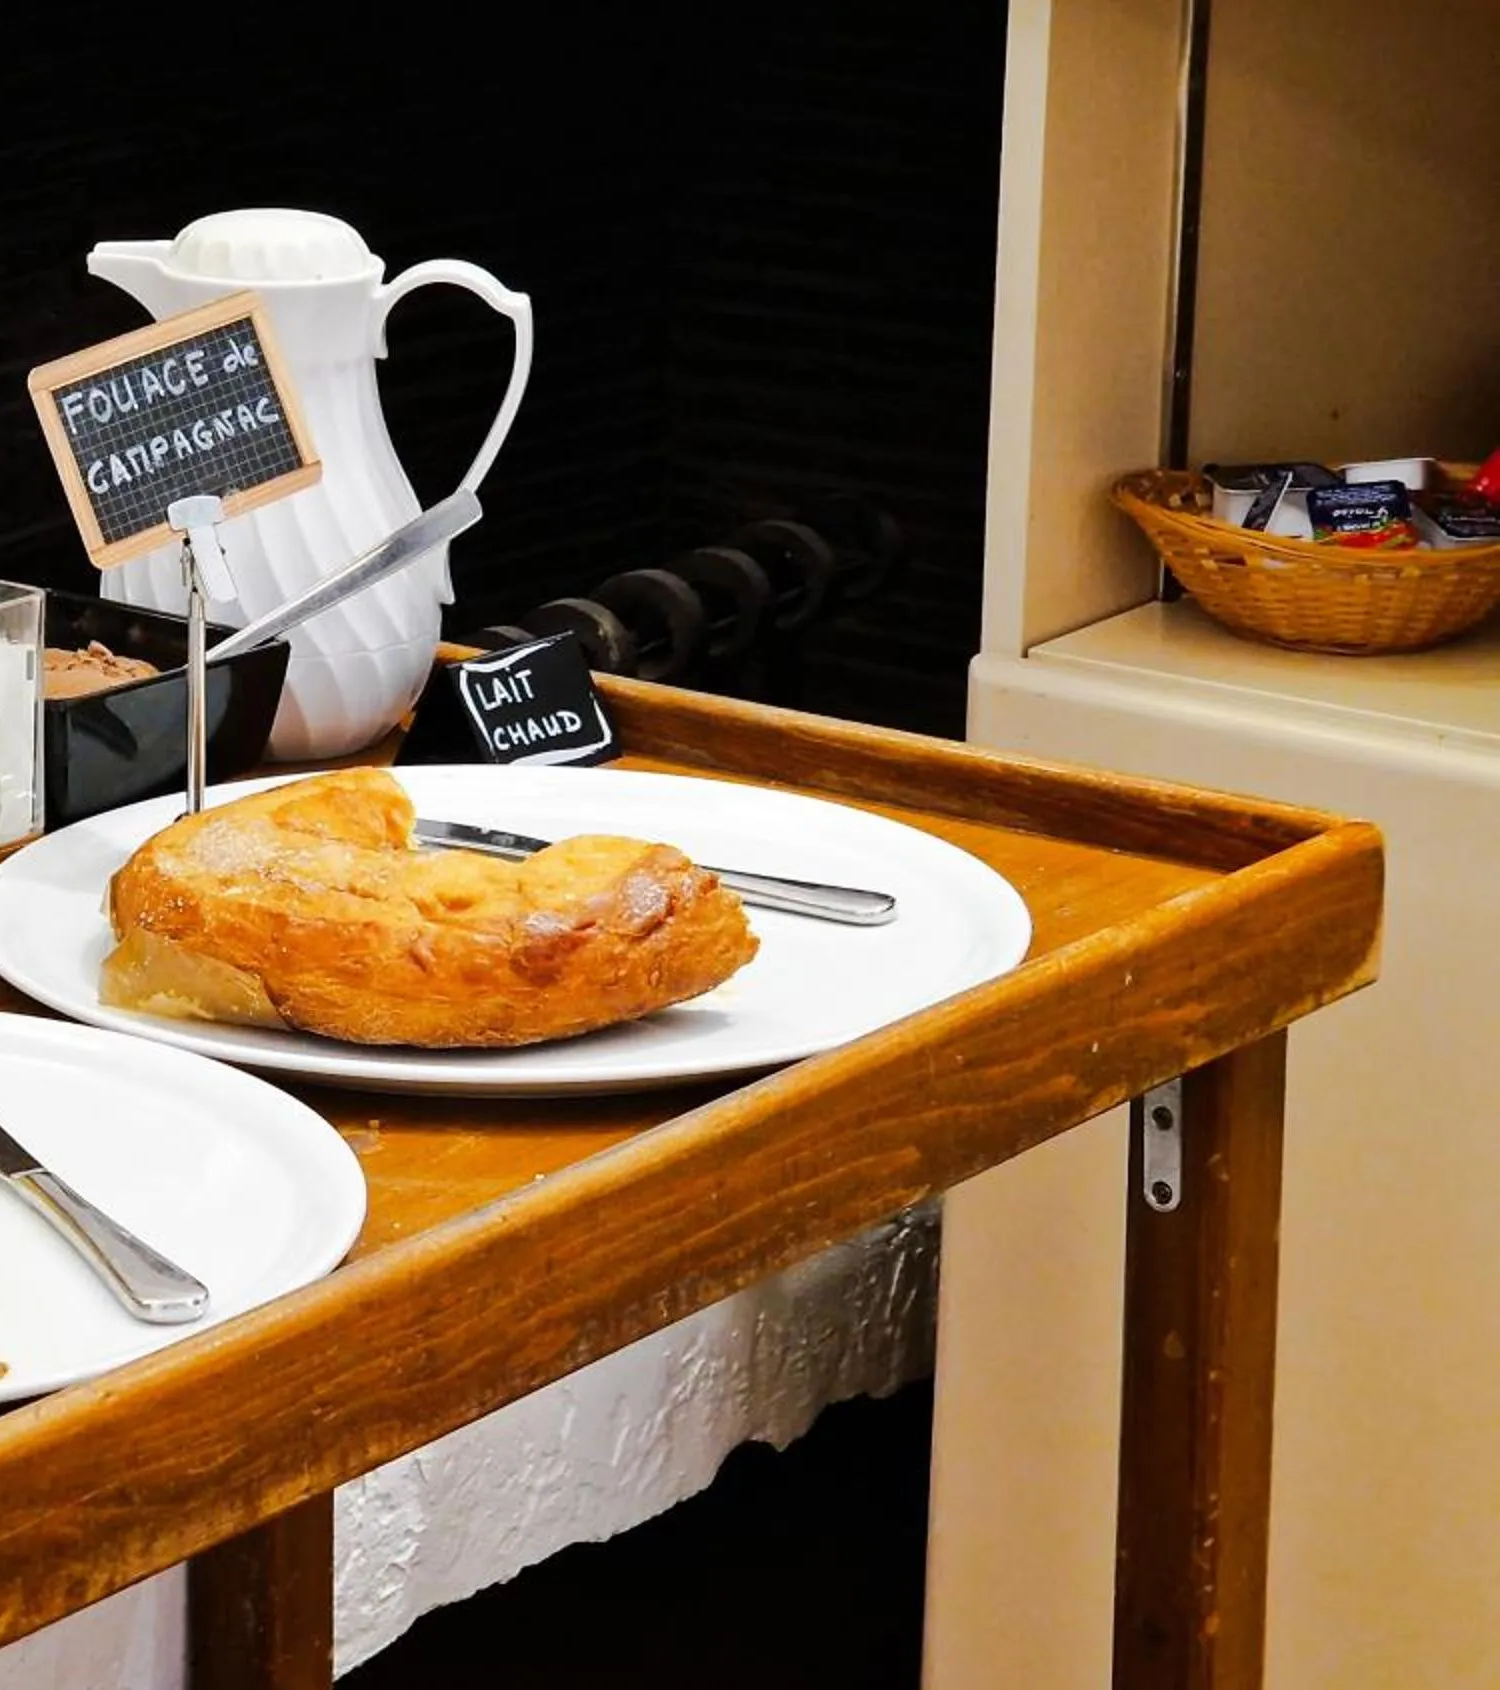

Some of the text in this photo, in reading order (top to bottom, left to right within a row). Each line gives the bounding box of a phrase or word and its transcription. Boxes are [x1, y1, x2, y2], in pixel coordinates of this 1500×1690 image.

[61, 338, 260, 435] FOUACE de
[87, 396, 280, 494] CAMPAGNAC
[493, 710, 583, 751] CHAUD
